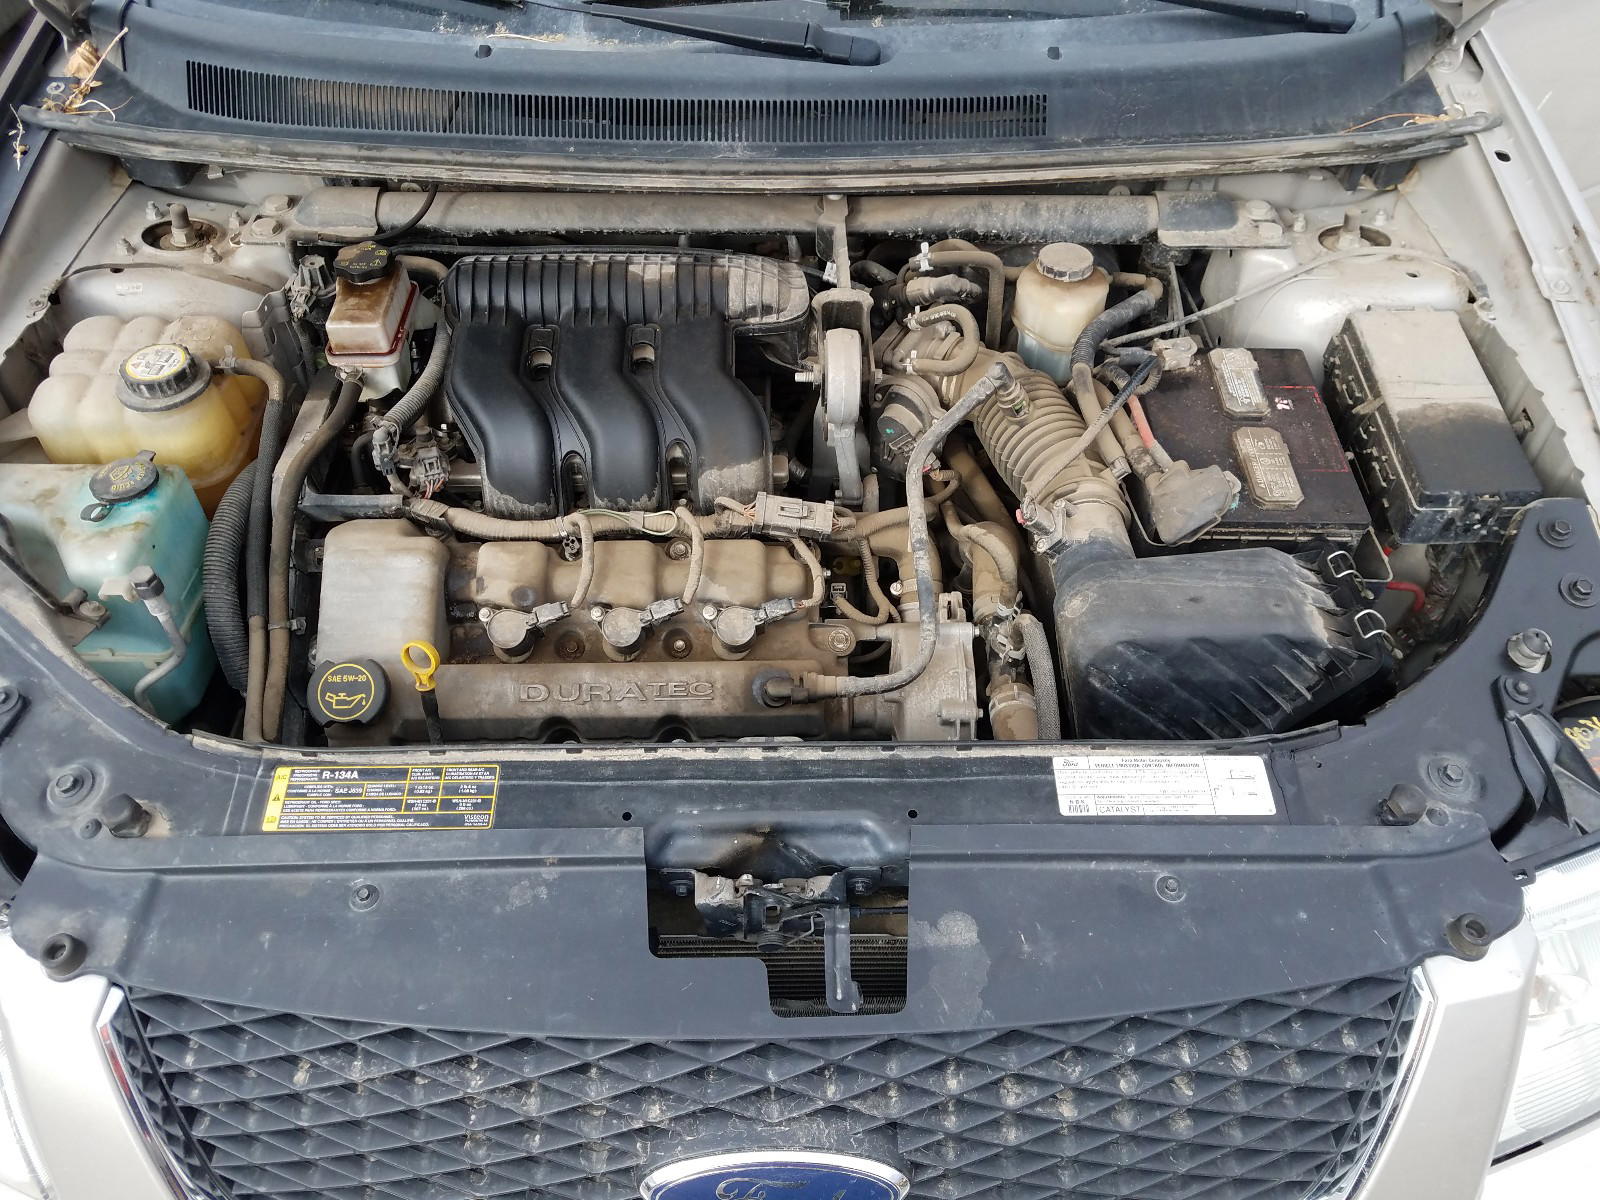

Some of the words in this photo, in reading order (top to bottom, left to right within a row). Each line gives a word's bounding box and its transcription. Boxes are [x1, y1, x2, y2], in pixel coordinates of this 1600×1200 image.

[327, 674, 342, 683] SAE
[342, 674, 367, 682] 5W-20
[519, 682, 714, 704] DURATEC
[322, 770, 359, 780] R-134A
[1099, 805, 1140, 814] CATALYST
